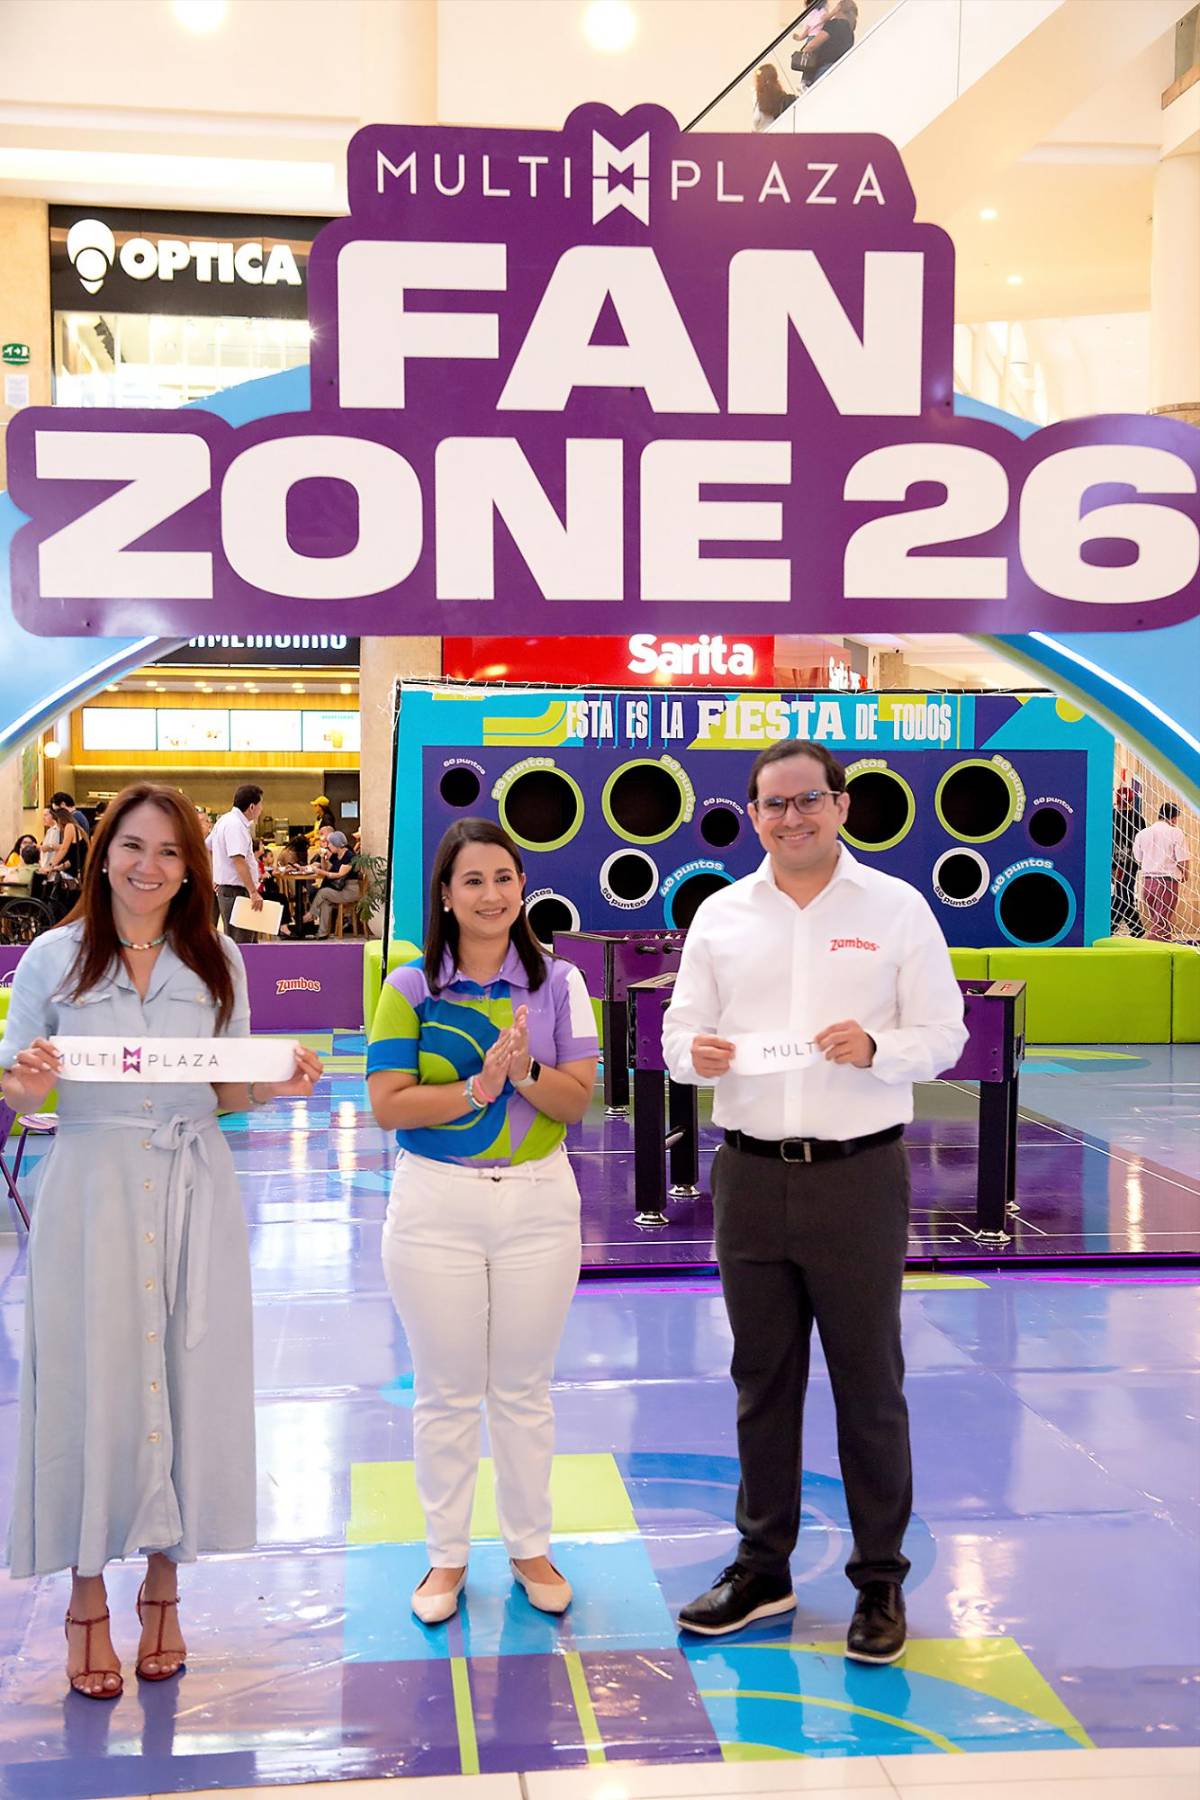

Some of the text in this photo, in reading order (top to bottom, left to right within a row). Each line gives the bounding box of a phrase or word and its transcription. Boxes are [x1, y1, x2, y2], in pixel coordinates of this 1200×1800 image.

[376, 150, 886, 206] MULTI PLAZA
[119, 237, 303, 286] OPTICA
[337, 239, 925, 417] FAN
[34, 430, 1200, 604] ZONE 26
[627, 634, 755, 676] Sarita
[567, 700, 952, 741] ESTA ES LA FIESTA DE TODOS
[456, 758, 486, 775] puntos
[504, 758, 553, 781] puntos
[845, 759, 888, 777] untos
[676, 768, 695, 821] puntos
[992, 754, 1026, 822] 20 puntos
[716, 798, 744, 815] puntos
[1046, 797, 1073, 814] puntos
[660, 860, 724, 896] 40 puntos
[1004, 859, 1054, 879] puntos
[525, 889, 552, 905] untos
[602, 887, 646, 909] 50 puntos
[943, 896, 978, 907] puntos
[762, 1040, 817, 1059] MULT
[147, 1054, 220, 1068] PLAZA
